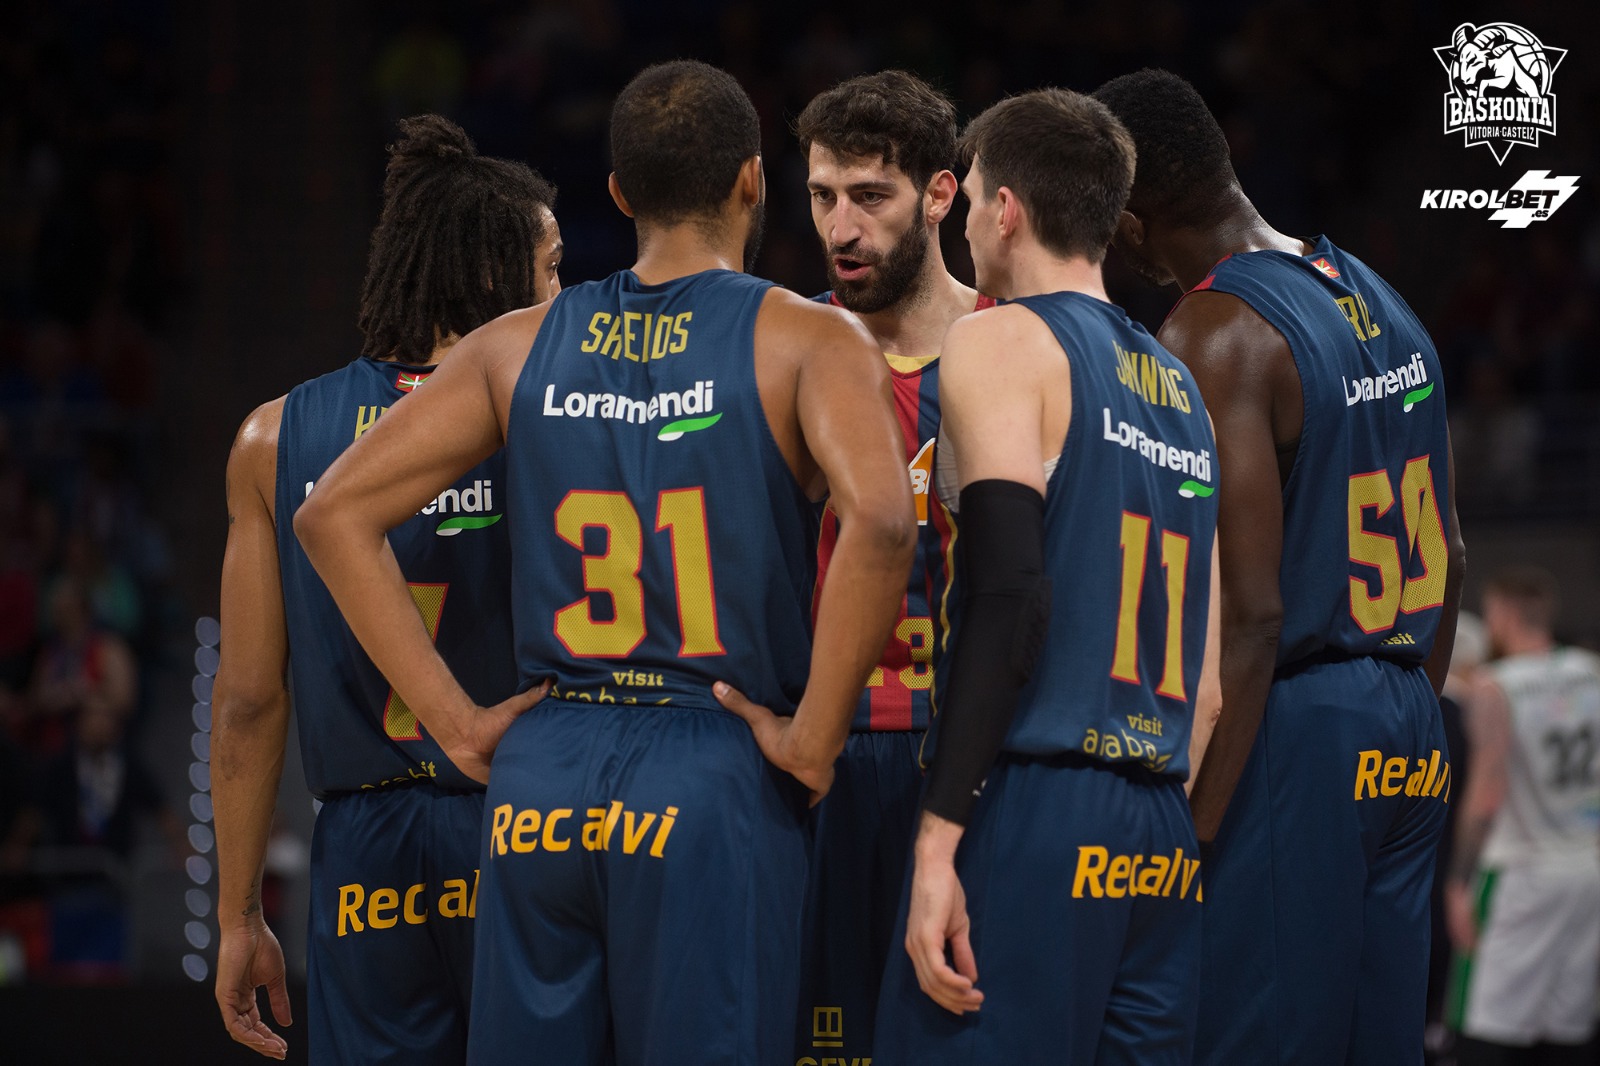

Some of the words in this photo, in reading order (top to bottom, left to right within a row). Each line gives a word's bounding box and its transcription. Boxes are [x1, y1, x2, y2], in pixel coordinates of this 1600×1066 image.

[543, 380, 714, 425] Loramendi
[1103, 407, 1212, 482] Loramendi
[553, 486, 728, 659] 31
[1347, 454, 1449, 635] 50
[1109, 510, 1191, 703] 11
[612, 669, 664, 686] visit
[1127, 712, 1163, 737] visit
[337, 869, 481, 938] Recal
